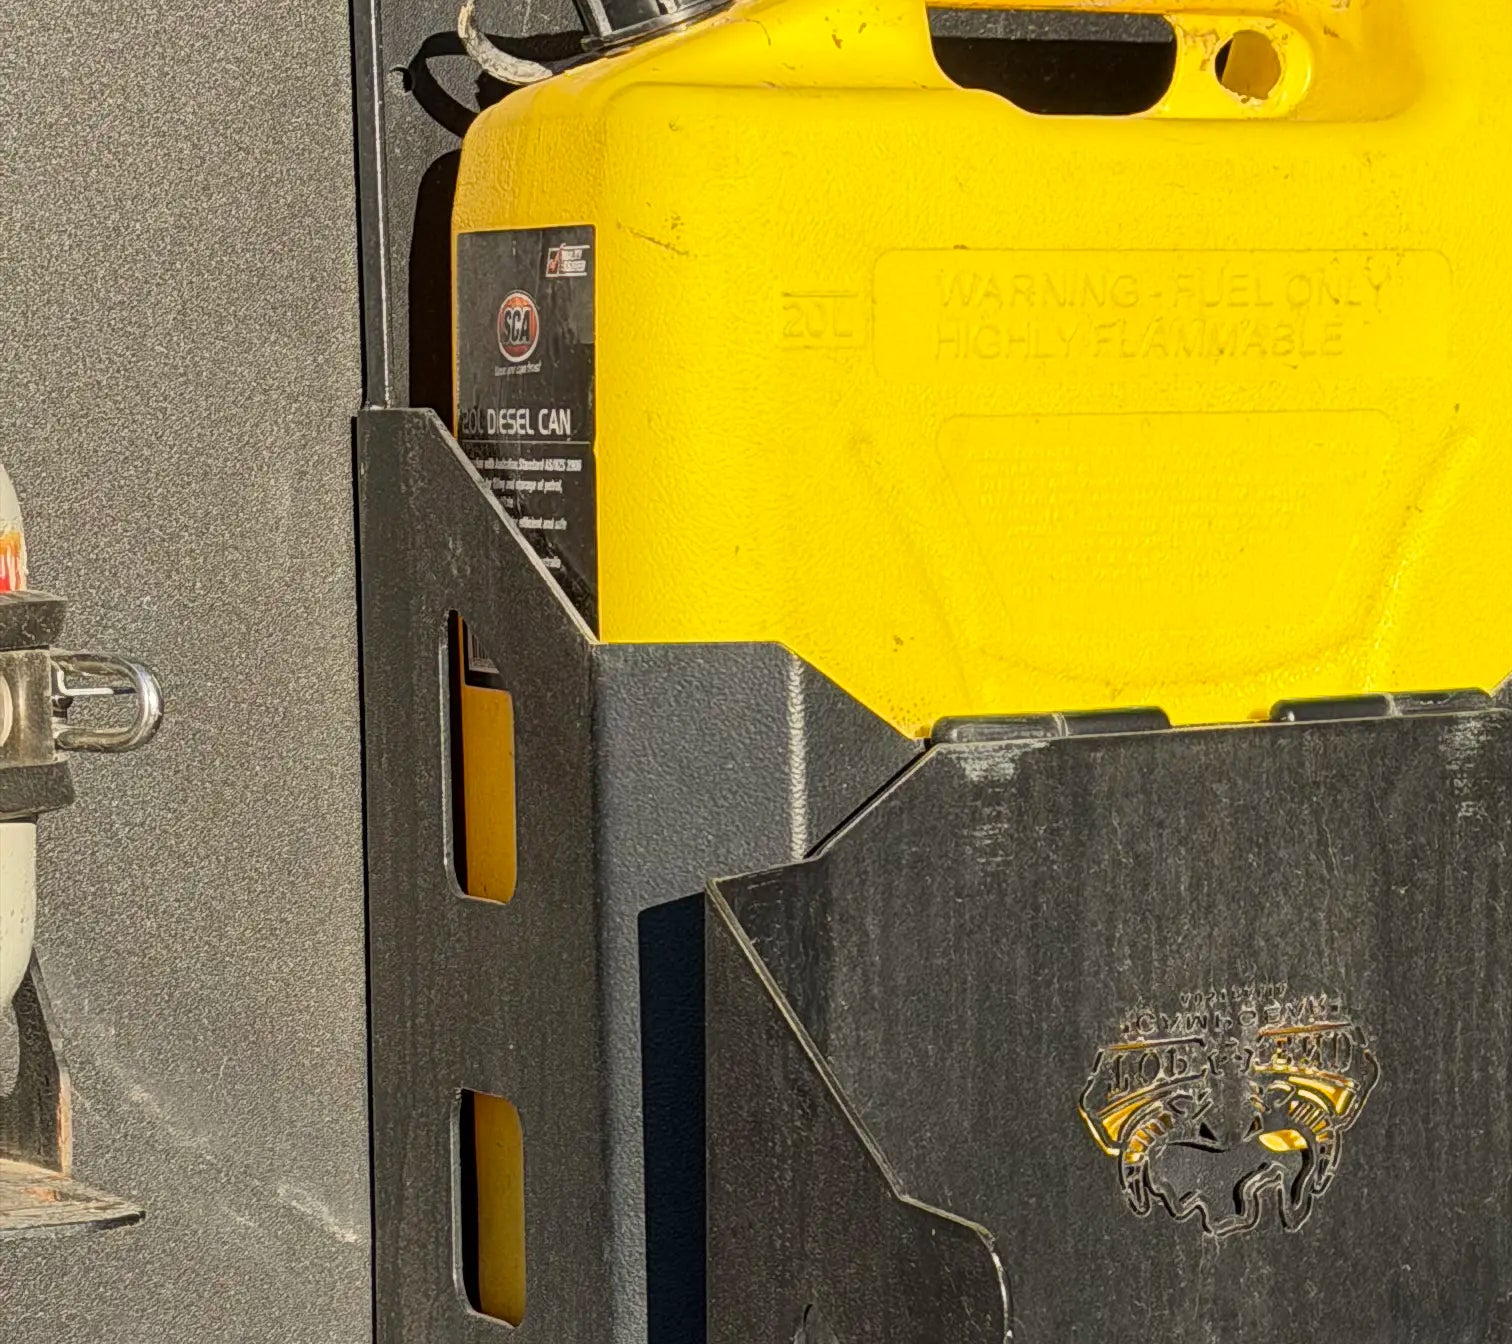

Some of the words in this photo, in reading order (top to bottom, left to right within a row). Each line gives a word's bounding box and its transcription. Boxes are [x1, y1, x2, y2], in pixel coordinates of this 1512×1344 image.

[939, 272, 1141, 309] WARNING
[1173, 270, 1273, 309] FUEL
[1286, 268, 1391, 308] ONLY
[503, 308, 531, 344] SCA
[935, 322, 1077, 361] HIGHLY
[1092, 319, 1345, 360] FLAMMABLE
[486, 407, 535, 436] DIESEL
[538, 408, 572, 436] CAN
